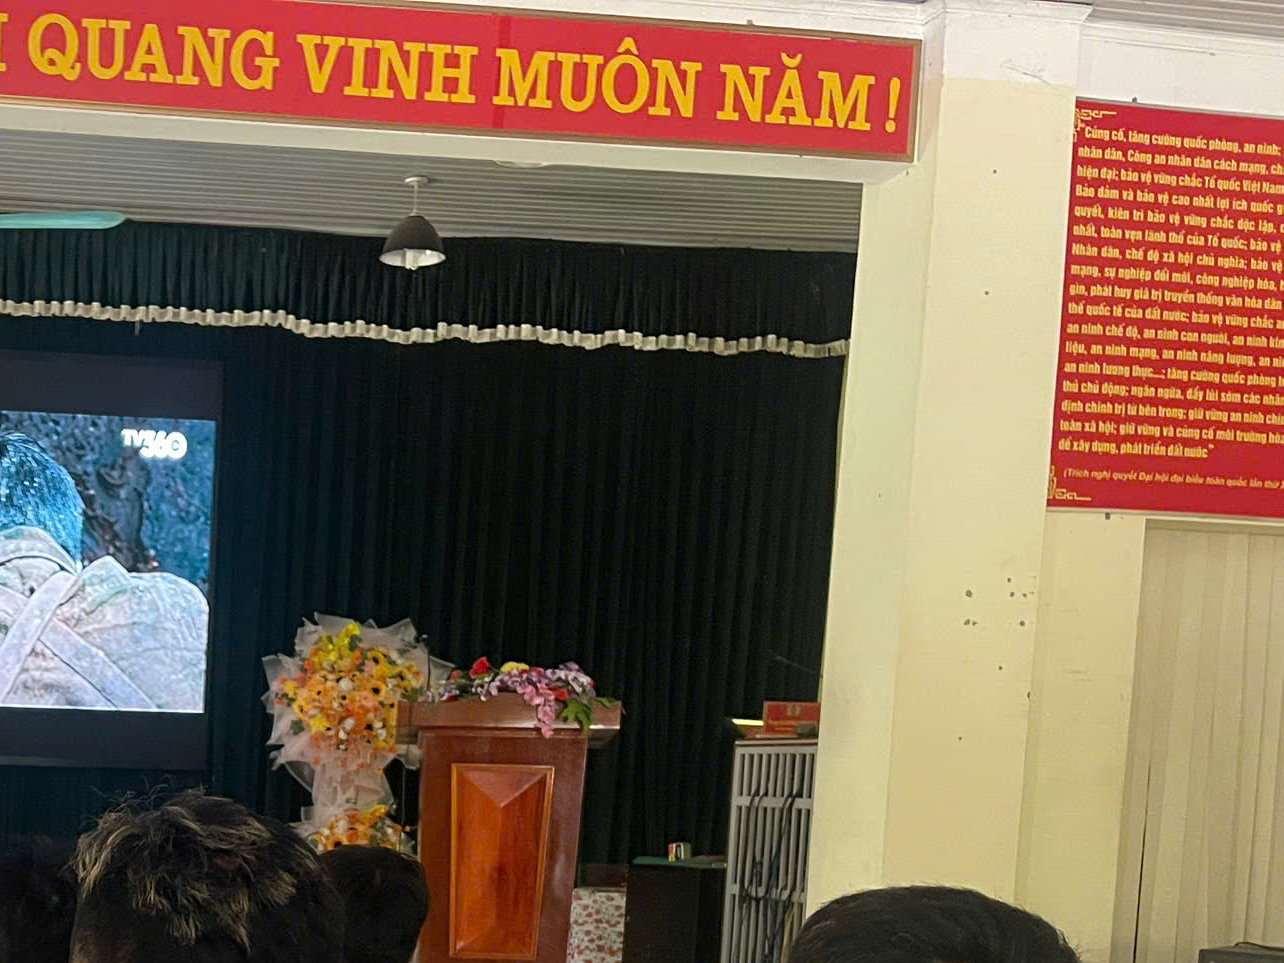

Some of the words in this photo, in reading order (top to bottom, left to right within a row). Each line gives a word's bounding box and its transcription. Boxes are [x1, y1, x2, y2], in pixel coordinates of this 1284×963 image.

[27, 13, 280, 91] QUANG
[296, 33, 478, 104] VINH
[492, 37, 702, 118] MUÔN
[716, 52, 875, 131] NĂM
[1172, 195, 1189, 205] cao
